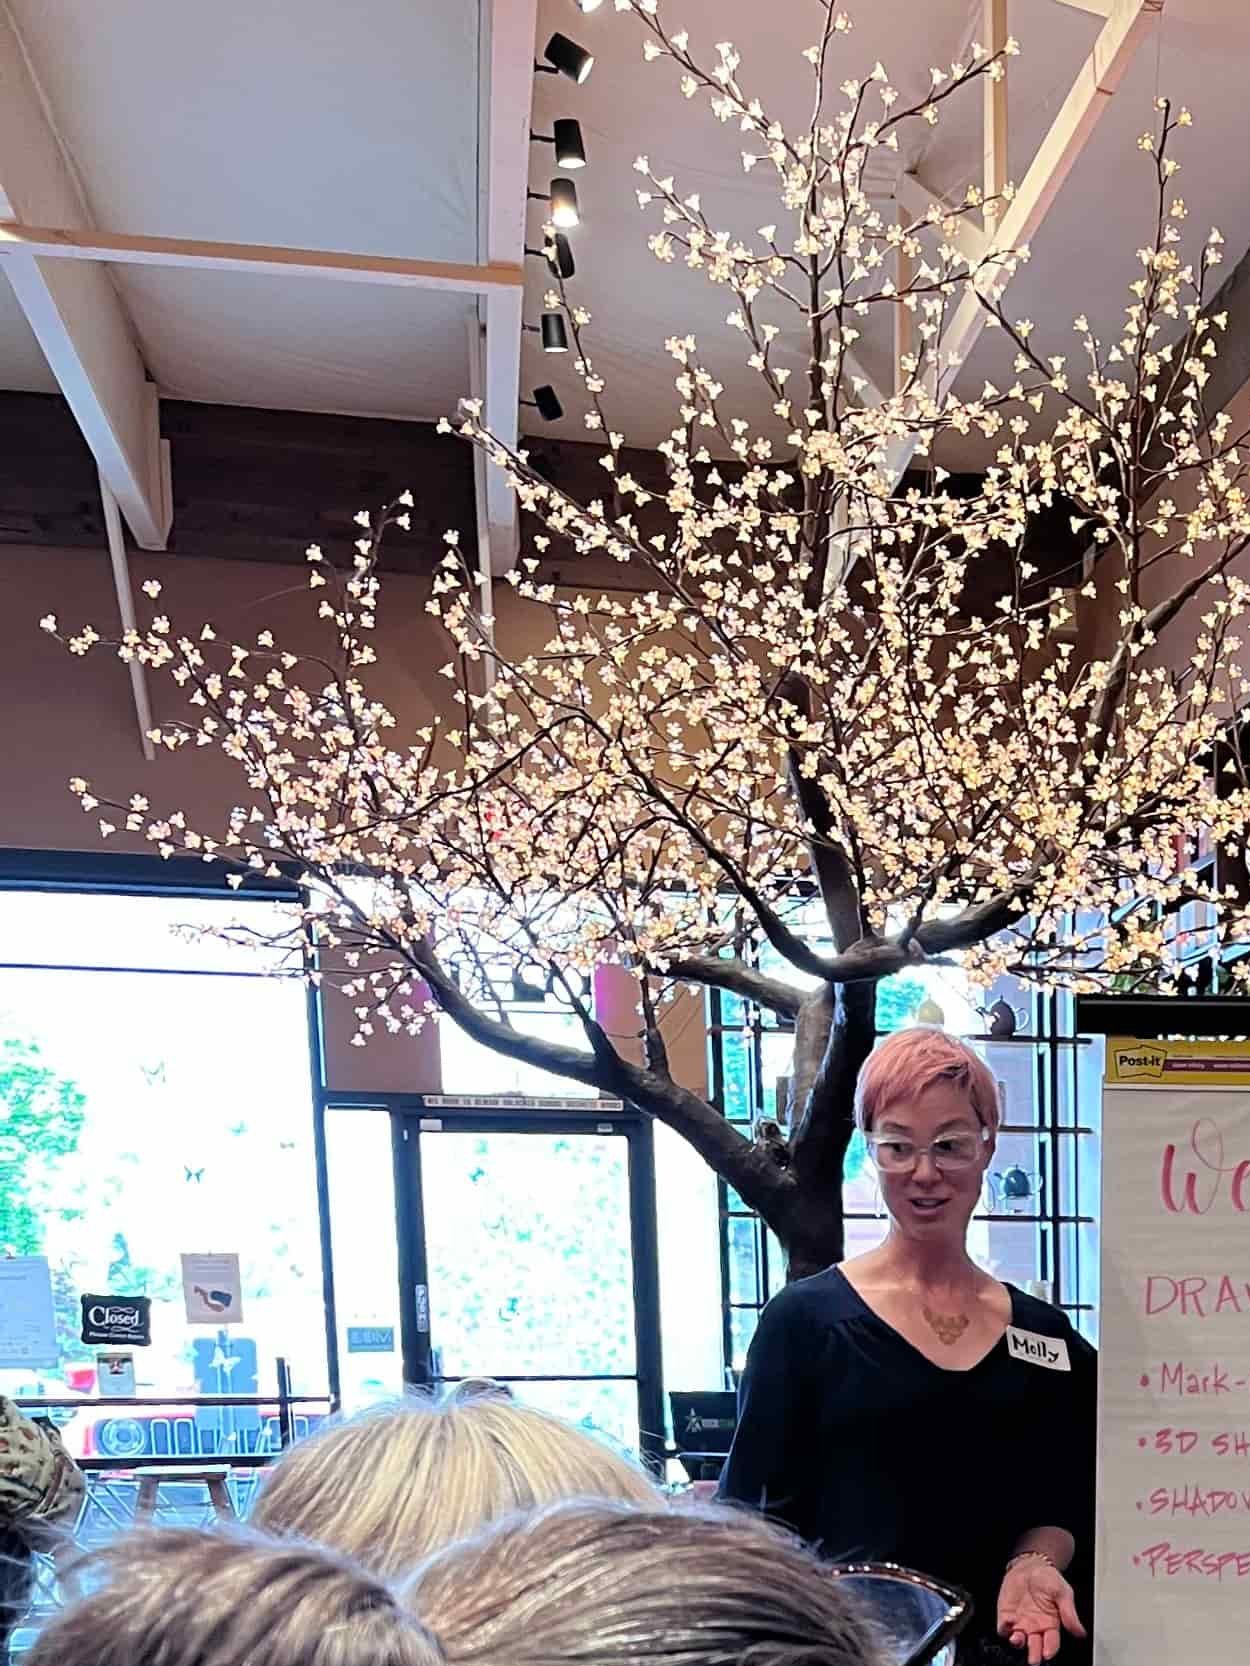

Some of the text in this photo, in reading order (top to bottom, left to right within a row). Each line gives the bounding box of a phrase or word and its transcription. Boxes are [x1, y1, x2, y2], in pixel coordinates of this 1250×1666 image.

[1119, 1054, 1161, 1068] Post-it
[88, 1305, 144, 1328] Closed
[1011, 1333, 1060, 1363] Molly
[1155, 1428, 1199, 1456] 3D
